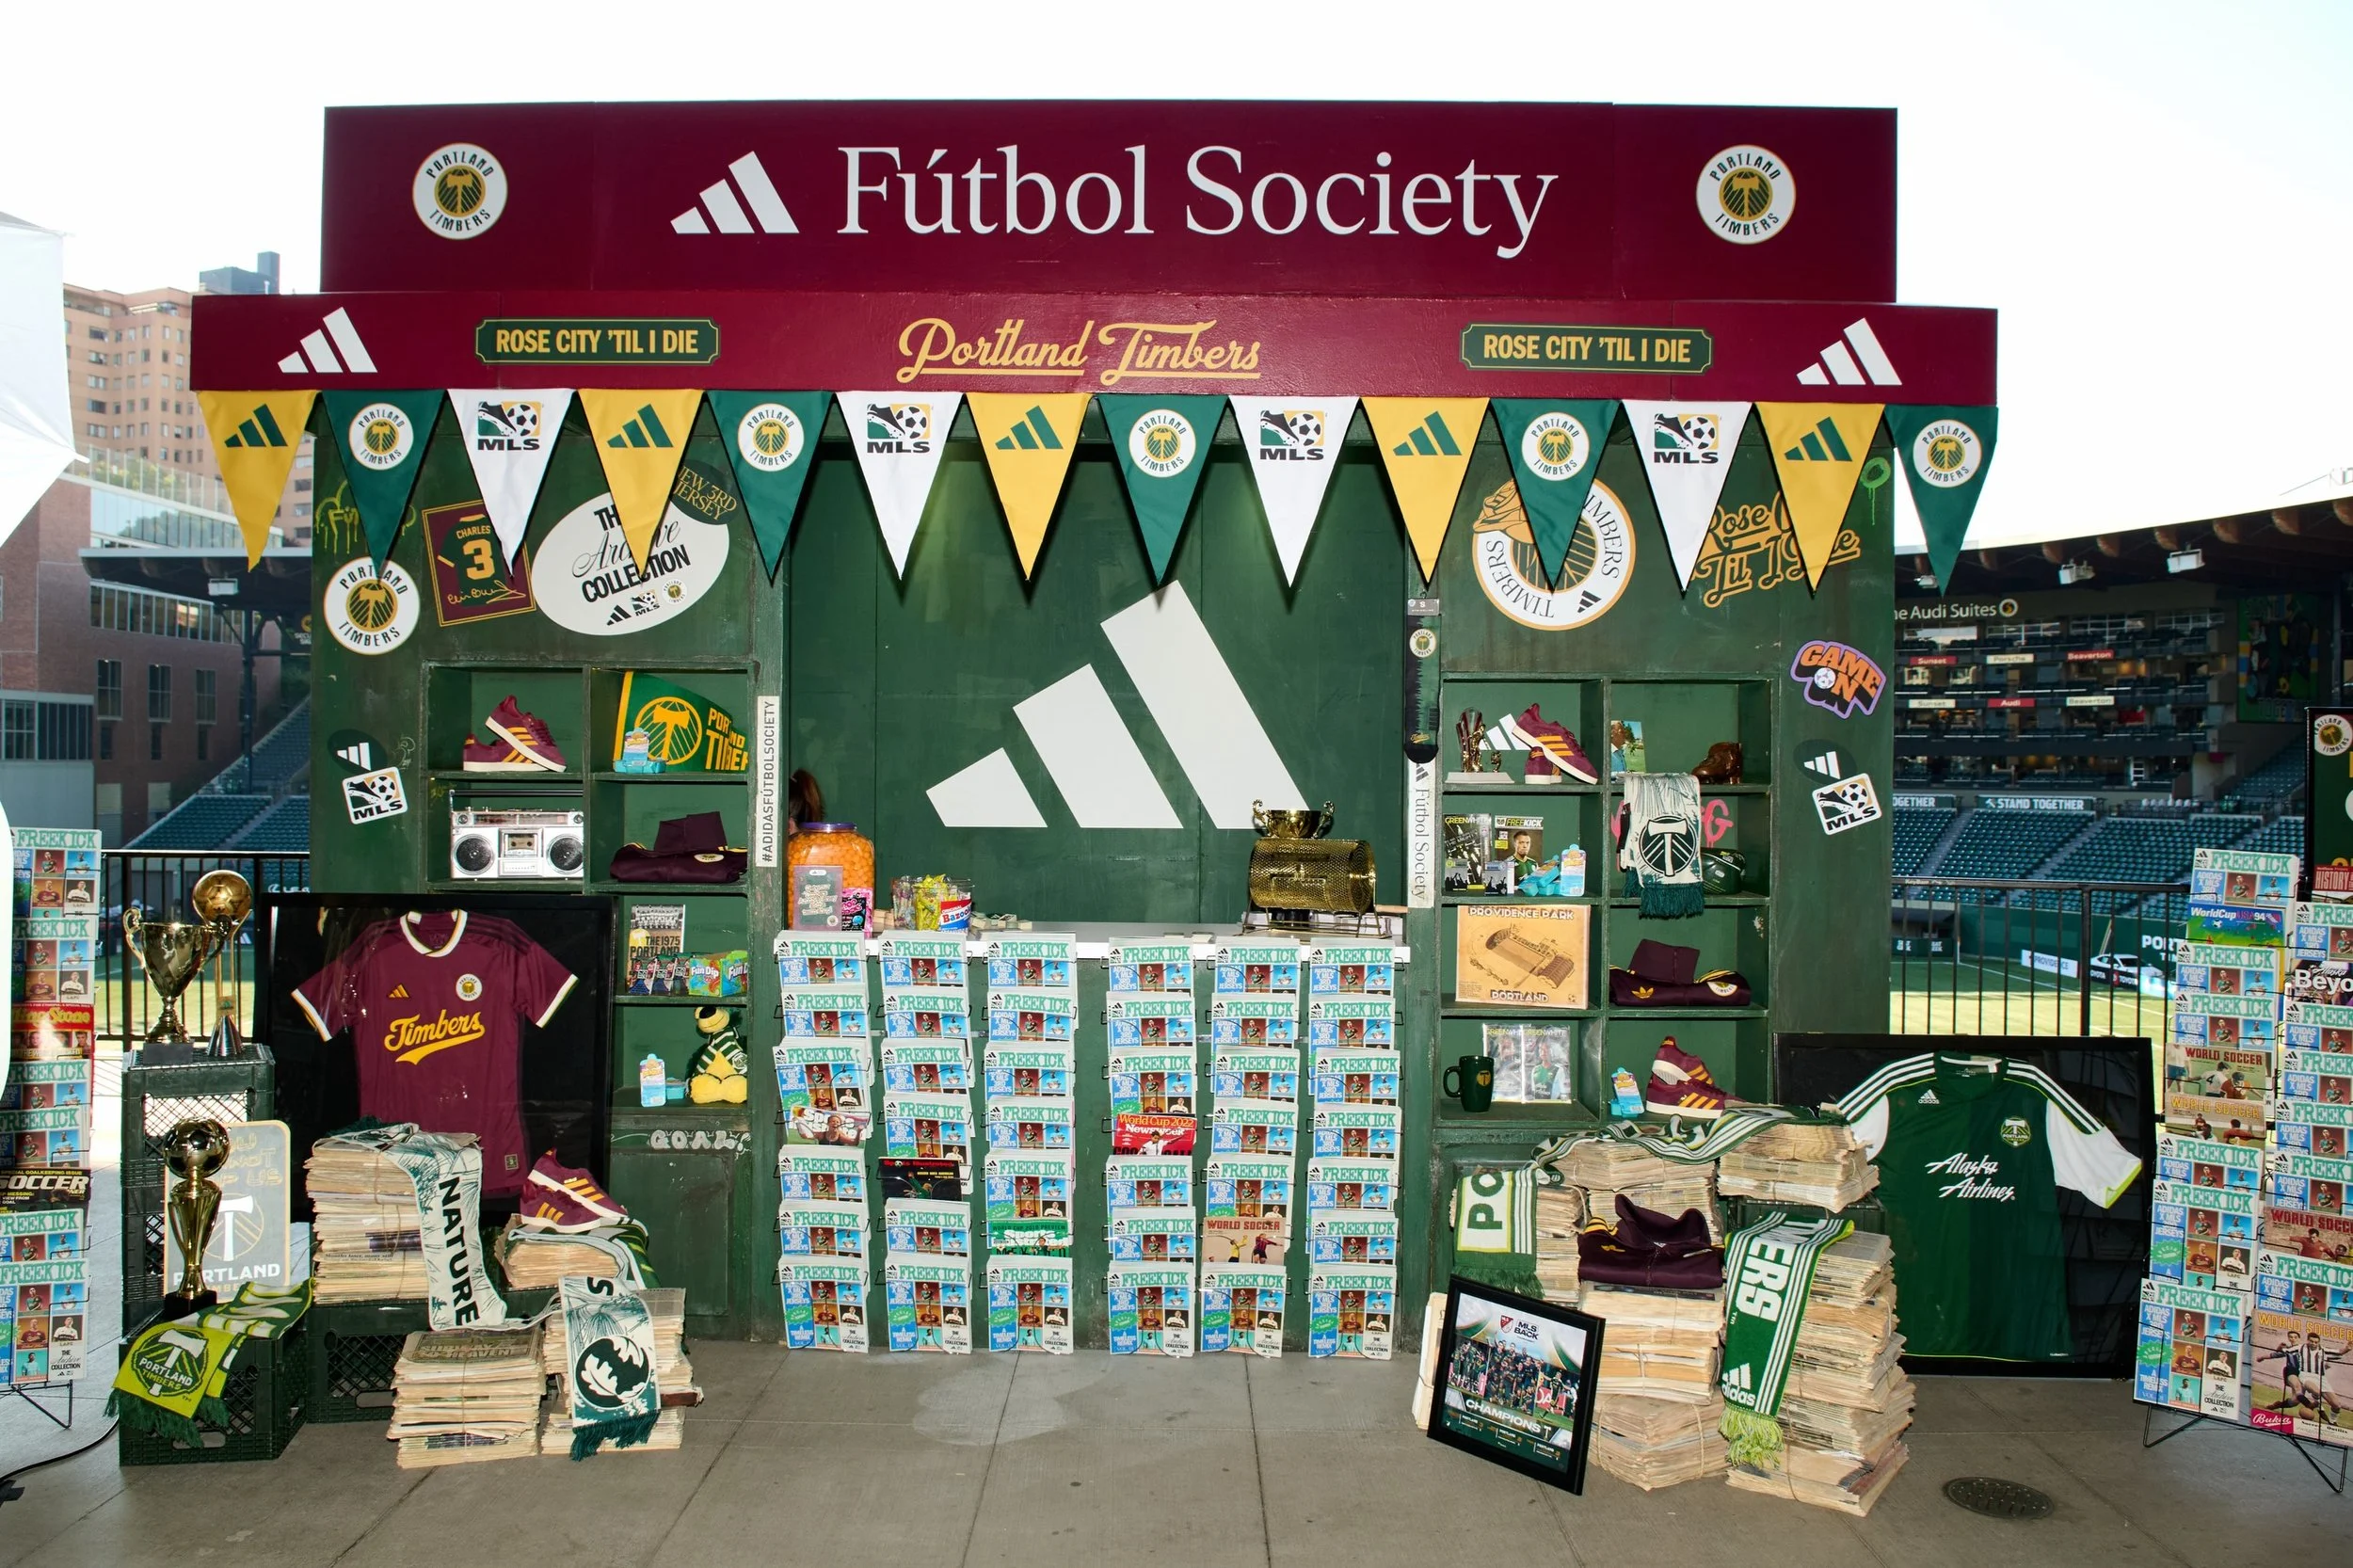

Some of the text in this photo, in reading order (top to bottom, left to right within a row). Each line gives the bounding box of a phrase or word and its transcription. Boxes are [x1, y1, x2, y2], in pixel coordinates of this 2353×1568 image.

[424, 149, 493, 181] PORTLAND
[1707, 151, 1781, 182] PORTLAND
[837, 144, 1559, 259] Fútbol Society
[429, 208, 492, 233] TIMBERS
[1714, 212, 1781, 237] TIMBERS
[495, 328, 552, 355] ROSE
[555, 328, 602, 355] CITY
[648, 328, 656, 355] I
[661, 328, 699, 355] DIE
[1483, 335, 1539, 360] ROSE
[1545, 336, 1593, 360] CITY
[1641, 338, 1648, 362] I
[1654, 338, 1691, 363] DIE
[896, 317, 1261, 386] Portland Timbers
[356, 409, 408, 431] PORTLAND
[744, 409, 796, 432] PORTLAND
[1136, 414, 1189, 437] PORTLAND
[1528, 417, 1581, 440] PORTLAND
[477, 437, 540, 452] MLS
[1920, 424, 1973, 447] PORTLAND
[867, 440, 930, 454] MLS
[1259, 446, 1324, 461] MLS
[360, 449, 406, 465] TIMBERS
[750, 449, 794, 466] TIMBERS
[1140, 455, 1186, 473] TIMBERS
[1654, 451, 1719, 465] MLS
[1532, 457, 1579, 477] TIMBERS
[1924, 466, 1970, 484] TIMBERS
[673, 481, 728, 520] JERSEY
[707, 485, 737, 513] 3RD
[594, 504, 621, 531] TH
[456, 523, 491, 540] CHARLES
[1584, 494, 1623, 579] IMBERS
[462, 539, 496, 580] 3
[340, 566, 408, 595] PORTAND
[1485, 540, 1555, 618] TIMBERS
[635, 603, 660, 616] MLS
[1910, 603, 1946, 619] Audi
[1950, 603, 1997, 617] Suites
[339, 620, 400, 647] TIMBERS
[2068, 650, 2112, 660] Beaverton
[1801, 643, 1881, 697] GAME
[1815, 666, 1858, 704] ON
[2323, 737, 2349, 753] TIMBERS
[353, 800, 403, 820] MLS
[1893, 796, 1936, 808] OGETHER
[1996, 798, 2085, 810] STAND TOGETHER
[1506, 818, 1542, 827] FREEKICK
[1826, 807, 1878, 831] MLS
[17, 829, 96, 848] FREEKICK
[1411, 789, 1430, 900] Fútbol Society
[2212, 851, 2293, 874] FREEKICK
[2315, 871, 2349, 890] HISTORY
[942, 904, 972, 923] Bazoo
[1468, 906, 1575, 921] PROVIDENCE PARK
[646, 936, 680, 946] THE 1975
[792, 941, 858, 957] FREEKICK
[895, 941, 961, 957] FREEKICK
[1001, 941, 1069, 958] FREEKICK
[1123, 946, 1191, 963] FREEKICK
[1230, 947, 1298, 964] FREEKICK
[1325, 947, 1393, 964] FREEKICK
[2194, 945, 2274, 969] FREEKICK
[691, 967, 719, 978] Fun Dip
[728, 964, 743, 980] Fun
[796, 994, 864, 1010] FREEKICK
[898, 995, 964, 1014] FREEKICK
[1004, 994, 1071, 1014] FREEKICK
[1490, 990, 1549, 1003] PORTLAND
[1125, 1000, 1193, 1017] FREEKICK
[1228, 1000, 1295, 1018] FREEKICK
[1323, 1001, 1391, 1018] FREEKICK
[2191, 994, 2274, 1018] FREEKICK
[383, 1009, 486, 1064] Timbers
[2185, 1048, 2263, 1065] WORLD SOCCER
[2206, 1075, 2215, 1084] 4
[899, 1102, 964, 1120] FREEKICK
[1002, 1105, 1069, 1123] FREEKICK
[2170, 1097, 2260, 1119] WORLD SOCCER
[1119, 1114, 1194, 1128] World Cup 2022
[1226, 1108, 1294, 1127] FREEKICK
[1328, 1112, 1396, 1128] FREEKICK
[1125, 1124, 1185, 1136] Newsweek
[2175, 1139, 2259, 1169] FREEKICK
[793, 1158, 859, 1174] FREEKICK
[1121, 1164, 1188, 1179] FREEKICK
[1925, 1152, 1998, 1176] Alaska
[1939, 1176, 2013, 1201] Airlines
[2170, 1184, 2253, 1213] FREEKICK
[1207, 1220, 1280, 1231] WORLD SOCCER
[2271, 1209, 2314, 1226] WORLD
[1328, 1221, 1396, 1236] FREEKICK
[439, 1176, 481, 1326] NATURE
[0, 1261, 86, 1285] FREEKICK
[173, 1263, 280, 1286] PRTLAND
[793, 1265, 859, 1281] FREEKICK
[900, 1265, 965, 1283] FREEKICK
[1001, 1268, 1069, 1284] FREEKICK
[1122, 1271, 1190, 1287] FREEKICK
[1218, 1273, 1285, 1288] FREEKICK
[1325, 1274, 1393, 1290] FREEKICK
[2157, 1284, 2241, 1317] FREEKICK
[2144, 1306, 2170, 1320] ADIDAS
[1517, 1320, 1538, 1333] MLS
[2259, 1313, 2302, 1332] WORLD
[1513, 1326, 1539, 1340] BACK
[139, 1357, 194, 1386] PORTLAND
[142, 1369, 182, 1390] TIMBERS
[2215, 1384, 2225, 1392] THE
[2203, 1397, 2234, 1408] COLLECTION
[1465, 1399, 1542, 1433] CHAMPIONS
[2252, 1413, 2292, 1427] Buka
